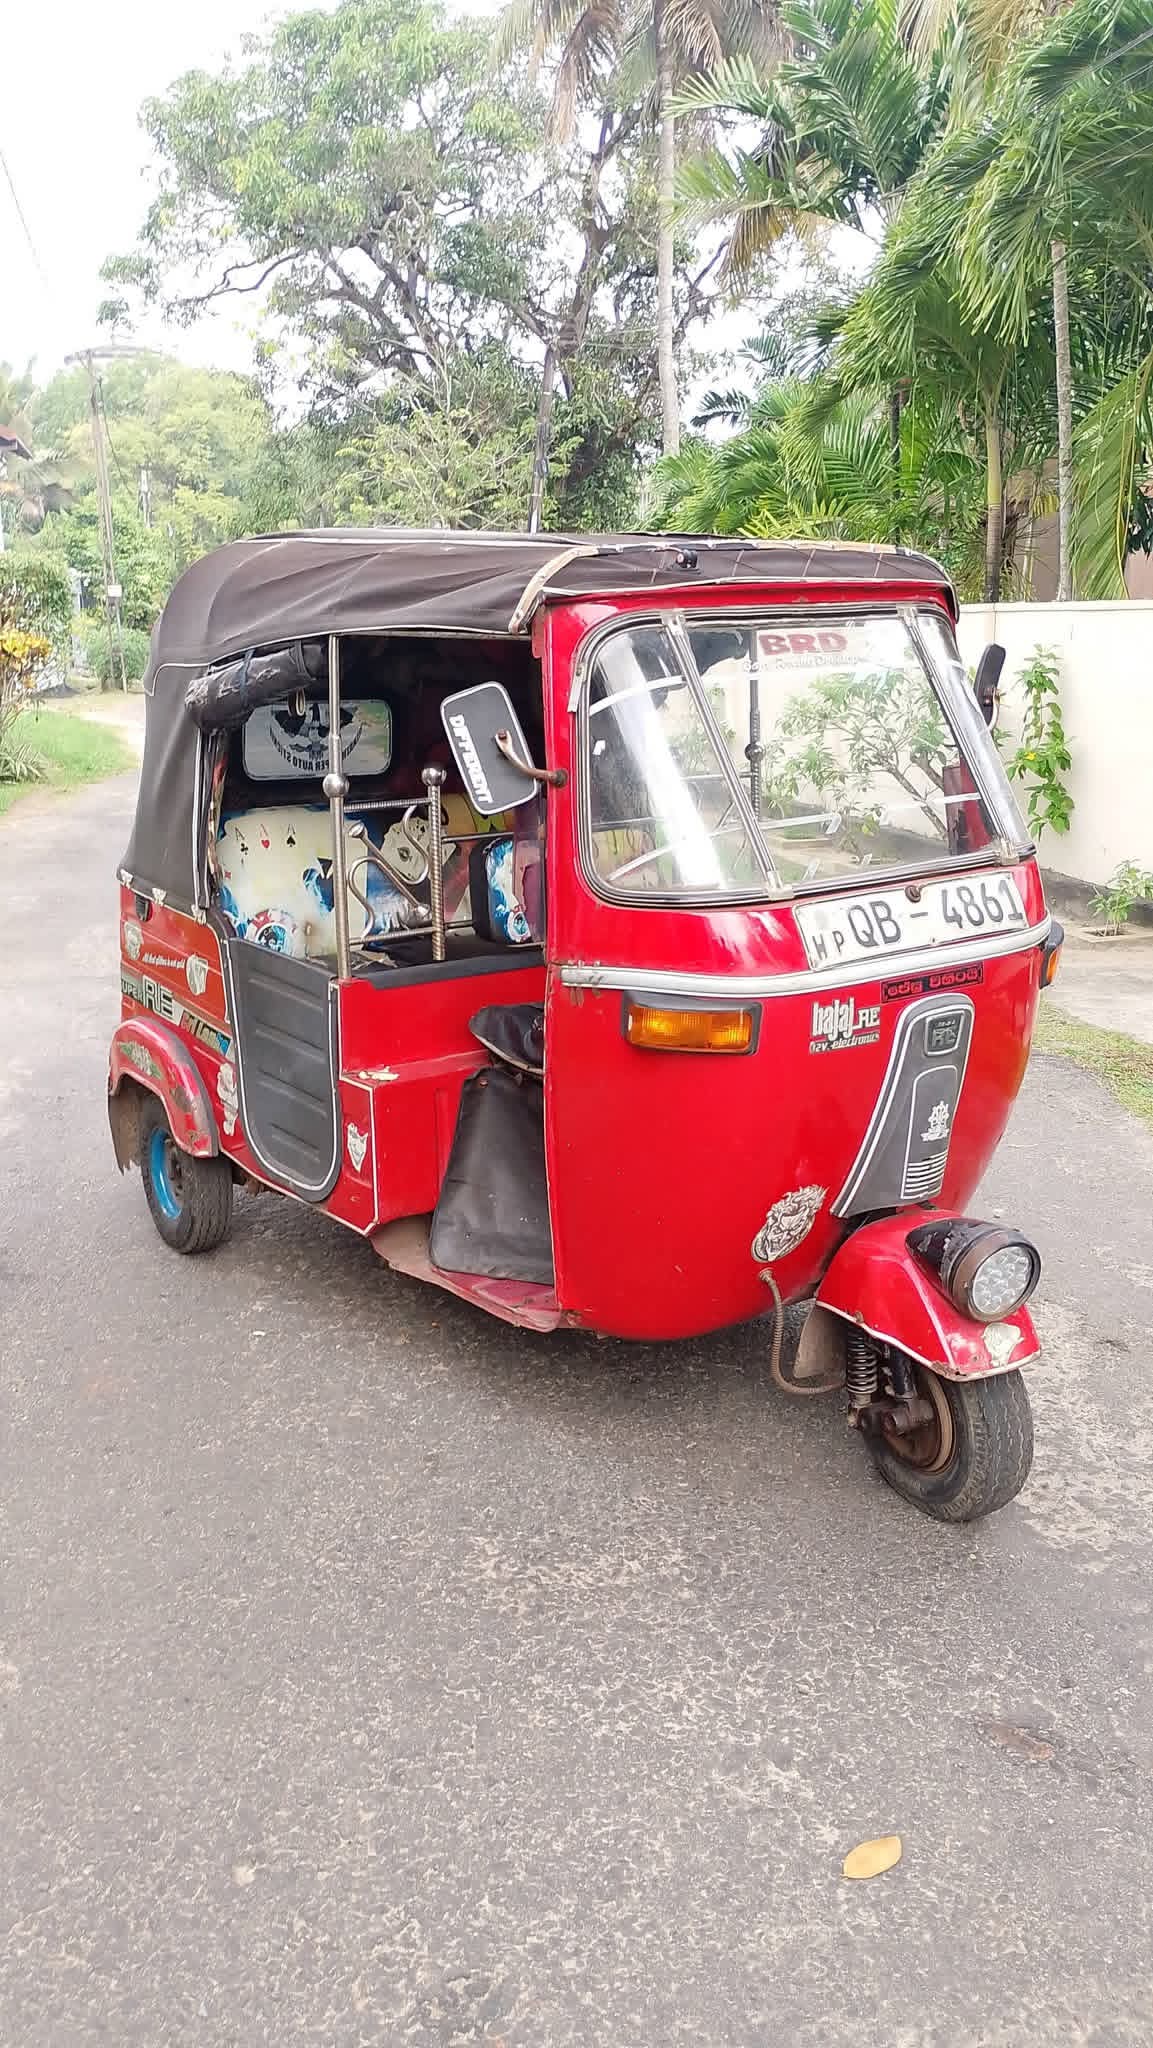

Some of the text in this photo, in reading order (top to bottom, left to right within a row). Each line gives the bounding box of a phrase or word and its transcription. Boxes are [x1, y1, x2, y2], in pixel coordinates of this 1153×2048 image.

[759, 632, 848, 656] BRD
[847, 899, 902, 948] QB
[941, 879, 1024, 930] 4861
[811, 996, 855, 1042] bajaj
